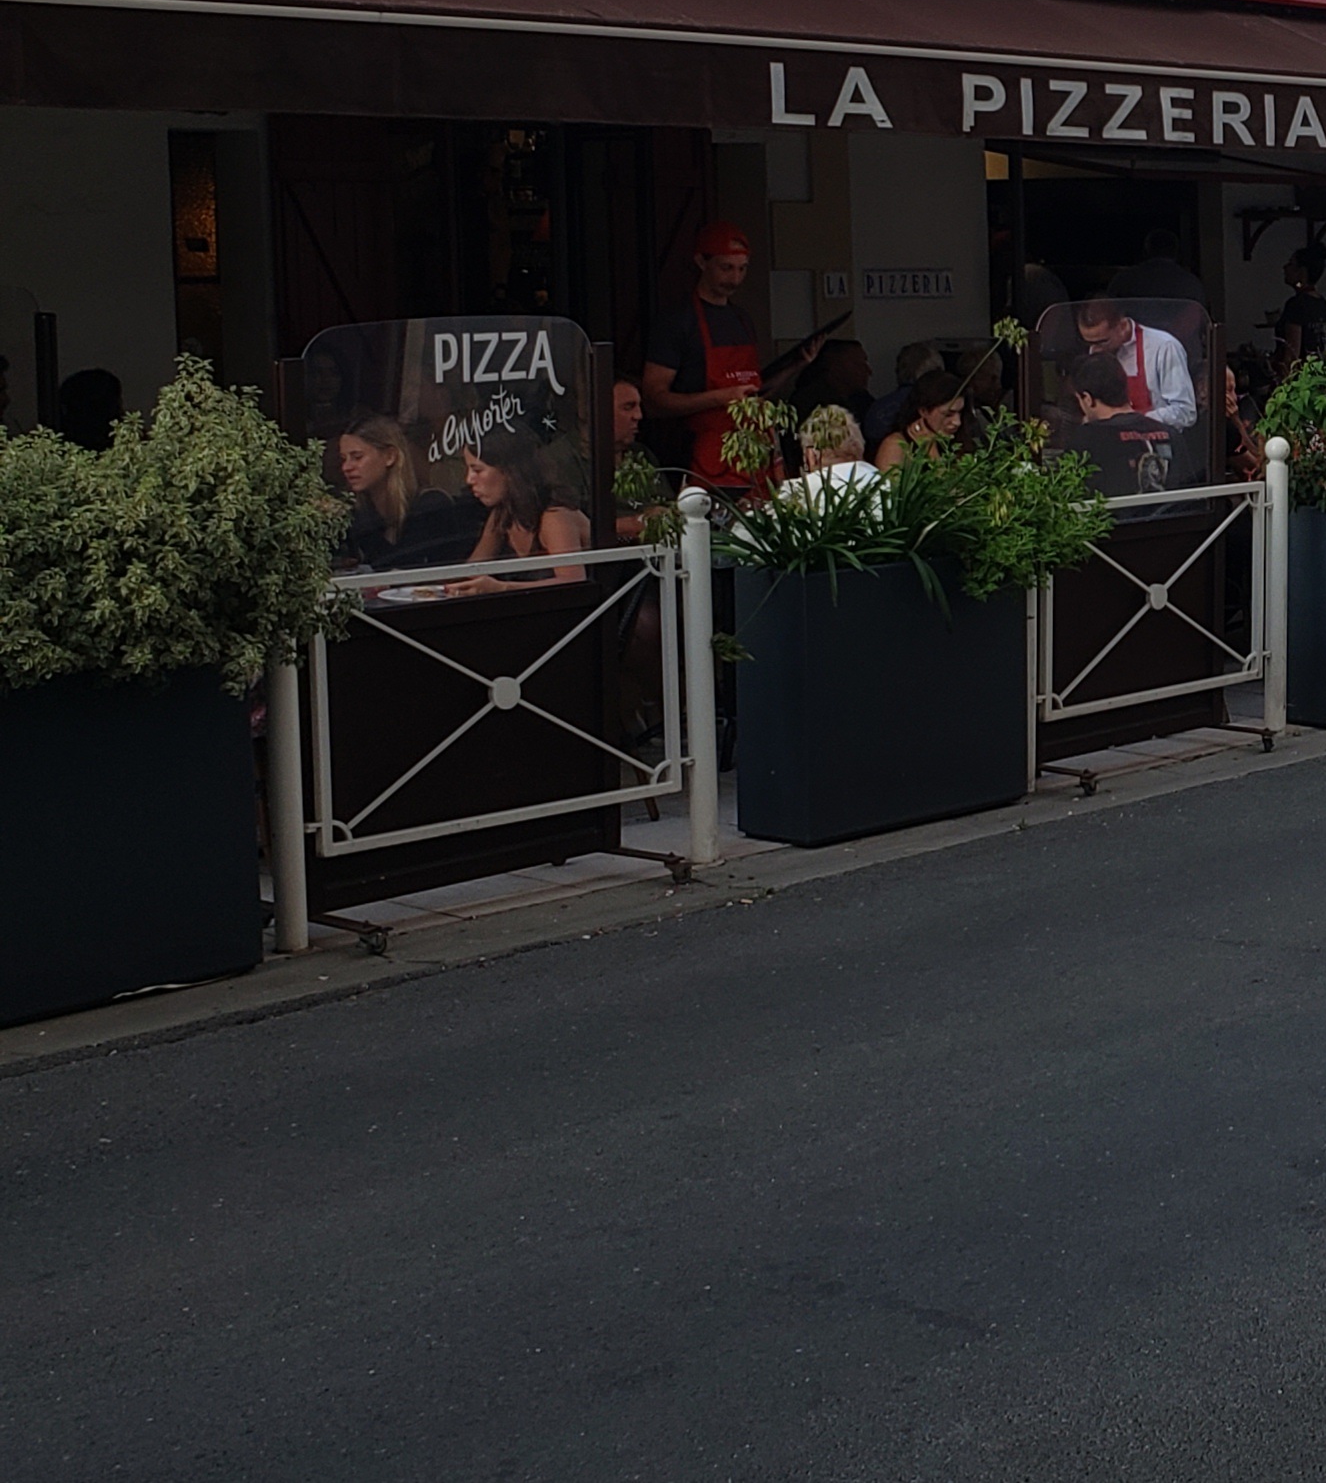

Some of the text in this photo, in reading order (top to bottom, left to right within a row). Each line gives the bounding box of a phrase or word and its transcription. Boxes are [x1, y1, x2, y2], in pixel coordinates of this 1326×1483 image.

[768, 61, 893, 130] LA
[826, 274, 952, 295] LA PIZZERIA
[433, 330, 566, 395] PIZZA
